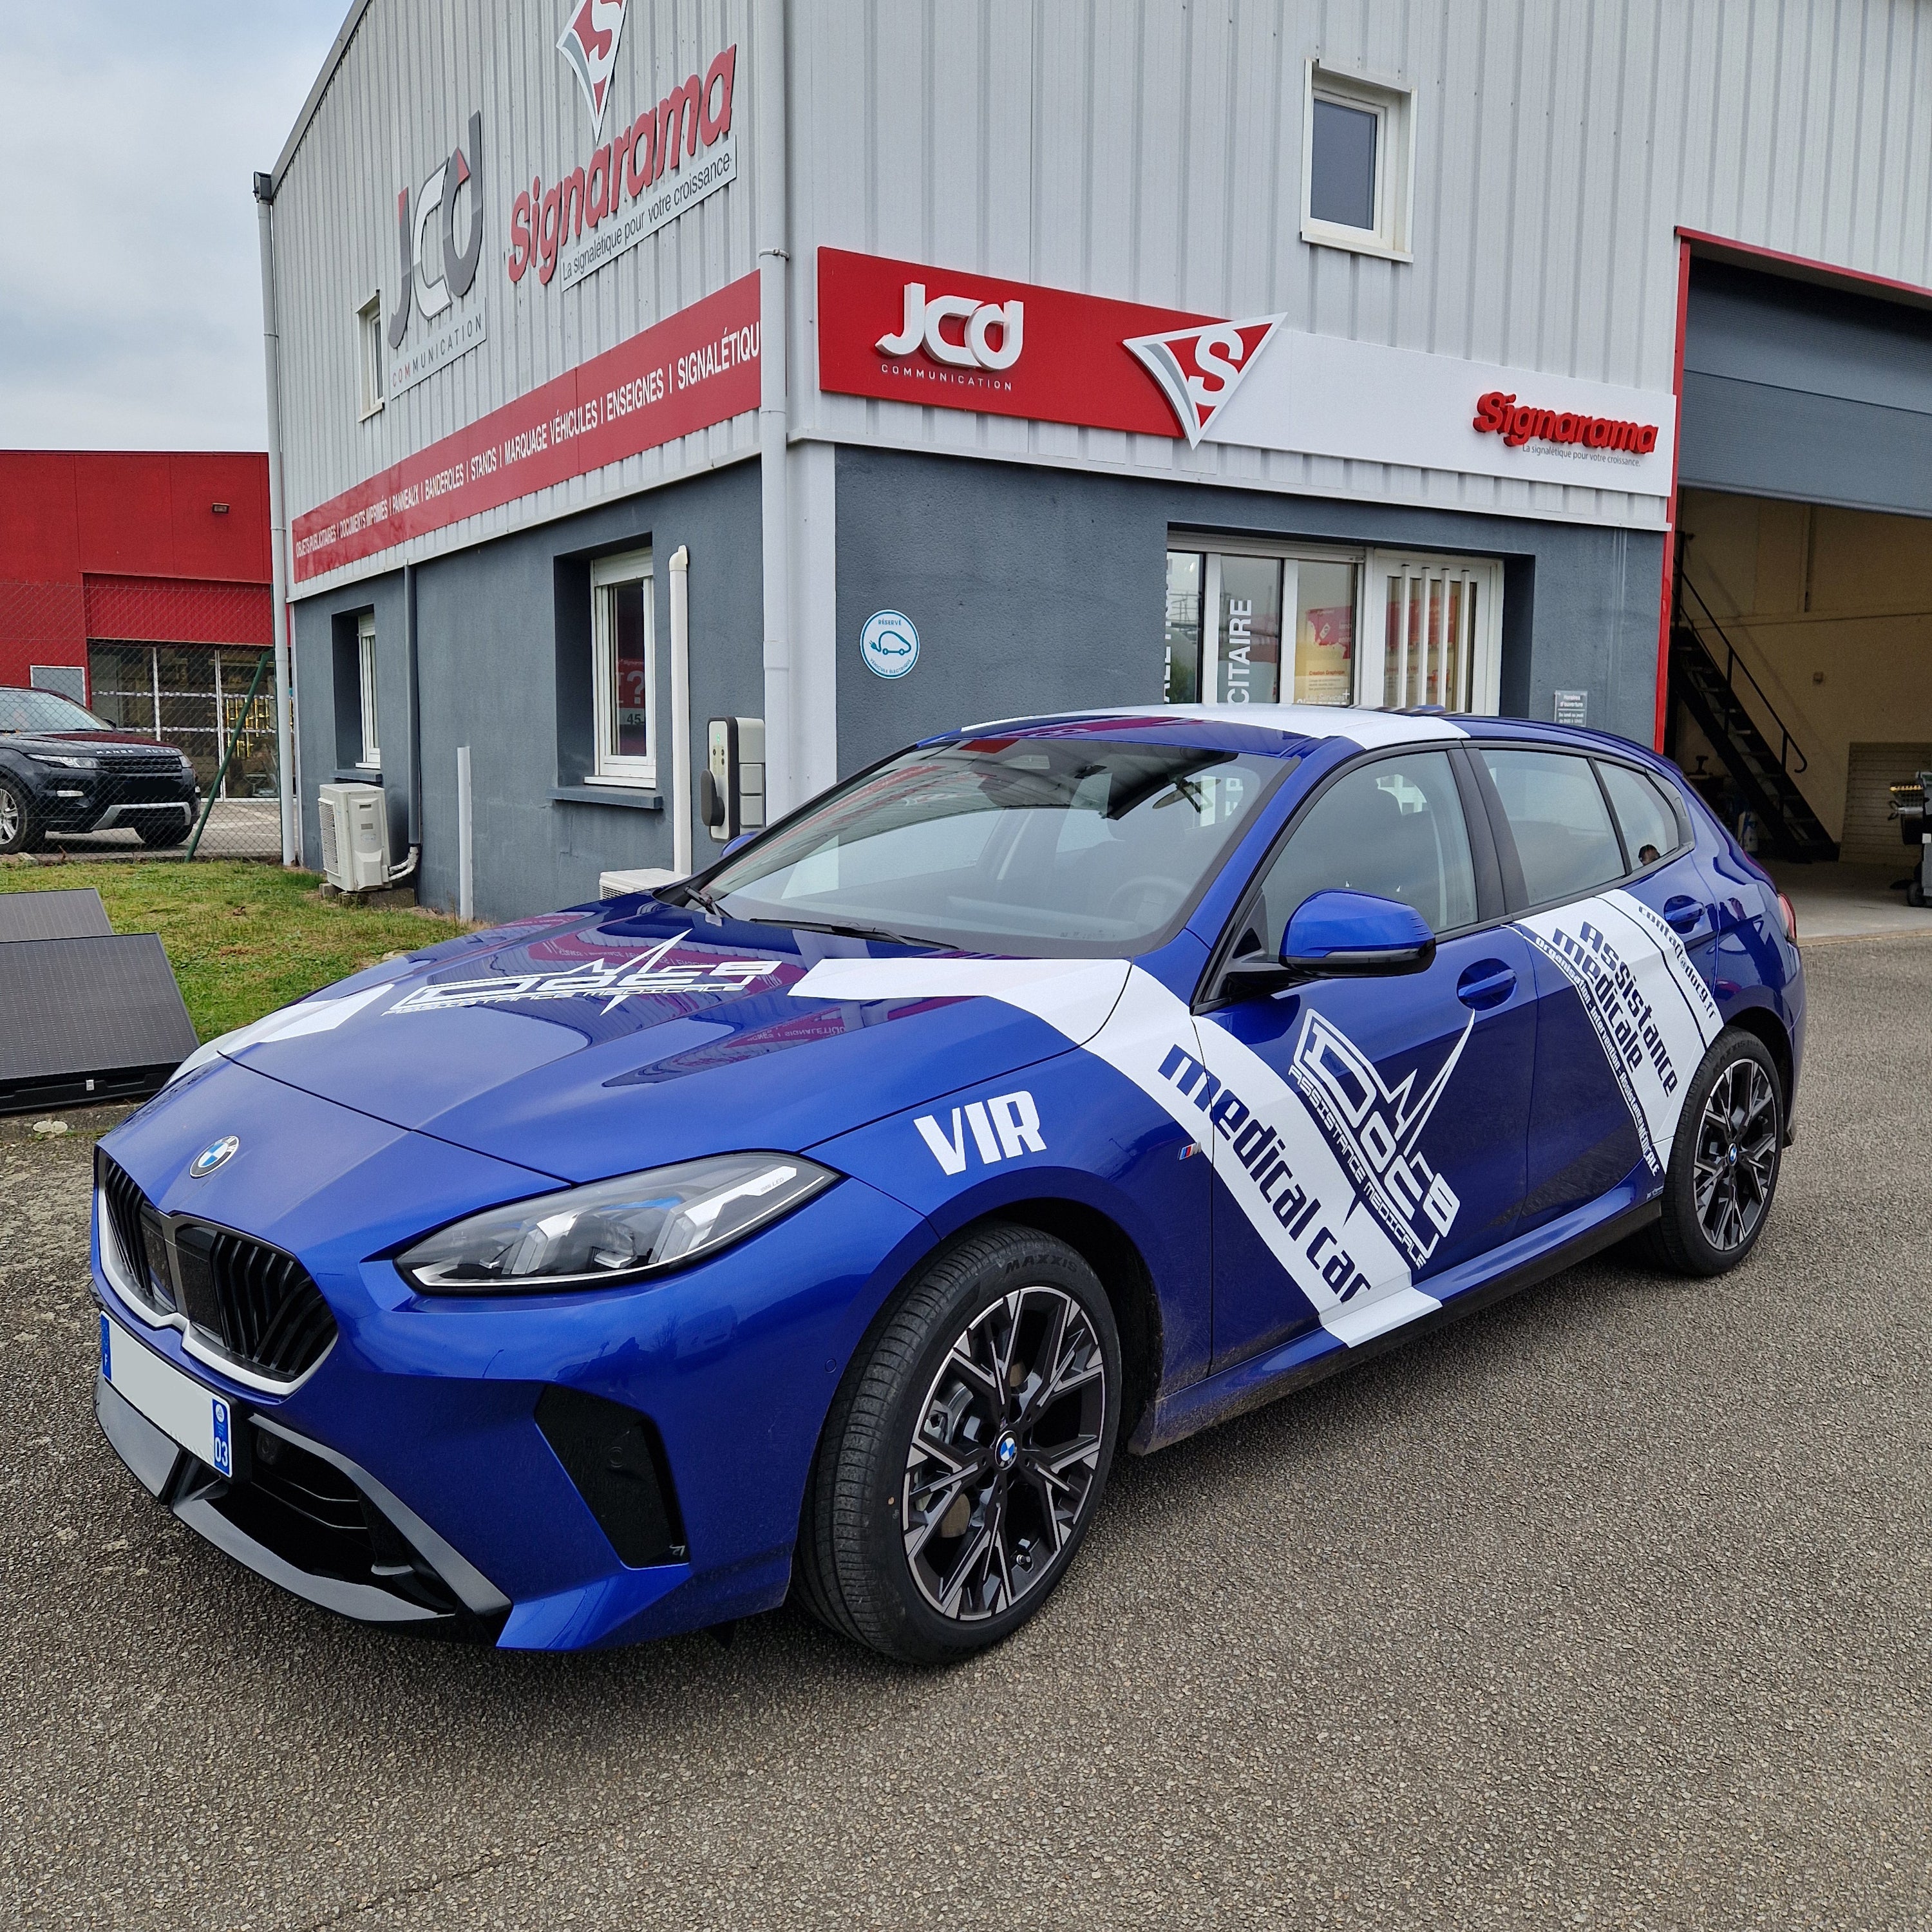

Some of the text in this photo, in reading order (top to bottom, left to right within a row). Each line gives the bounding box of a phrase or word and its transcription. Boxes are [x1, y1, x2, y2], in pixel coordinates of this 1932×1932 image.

[508, 44, 736, 285] Signarama
[563, 261, 573, 281] La
[574, 227, 622, 274] signalétique
[625, 211, 645, 245] pour
[648, 196, 671, 223] votre
[392, 314, 482, 387] COMMUNICATION
[882, 364, 1012, 390] COMMUNICATION
[339, 511, 366, 538] DOCUMENTS
[366, 495, 388, 526] IMPRIMÉS
[393, 484, 419, 514] PANNEAUX
[425, 463, 464, 500] BANDEROLES
[471, 447, 497, 481] STANDS
[504, 423, 547, 466] MARQUAGE
[549, 399, 597, 446] VÉHICULES
[607, 368, 663, 422] ENSEIGNES
[1473, 392, 1659, 454] Signarama
[1522, 444, 1531, 452] La
[1531, 444, 1571, 459] signalétique
[1573, 451, 1589, 460] pour
[1589, 453, 1606, 462] votre
[1580, 921, 1678, 1098] Assistance
[913, 1090, 1047, 1176] VIR
[1157, 1043, 1372, 1305] medical car
[1005, 1255, 1077, 1274] MAXXIS
[214, 1437, 228, 1467] 03
